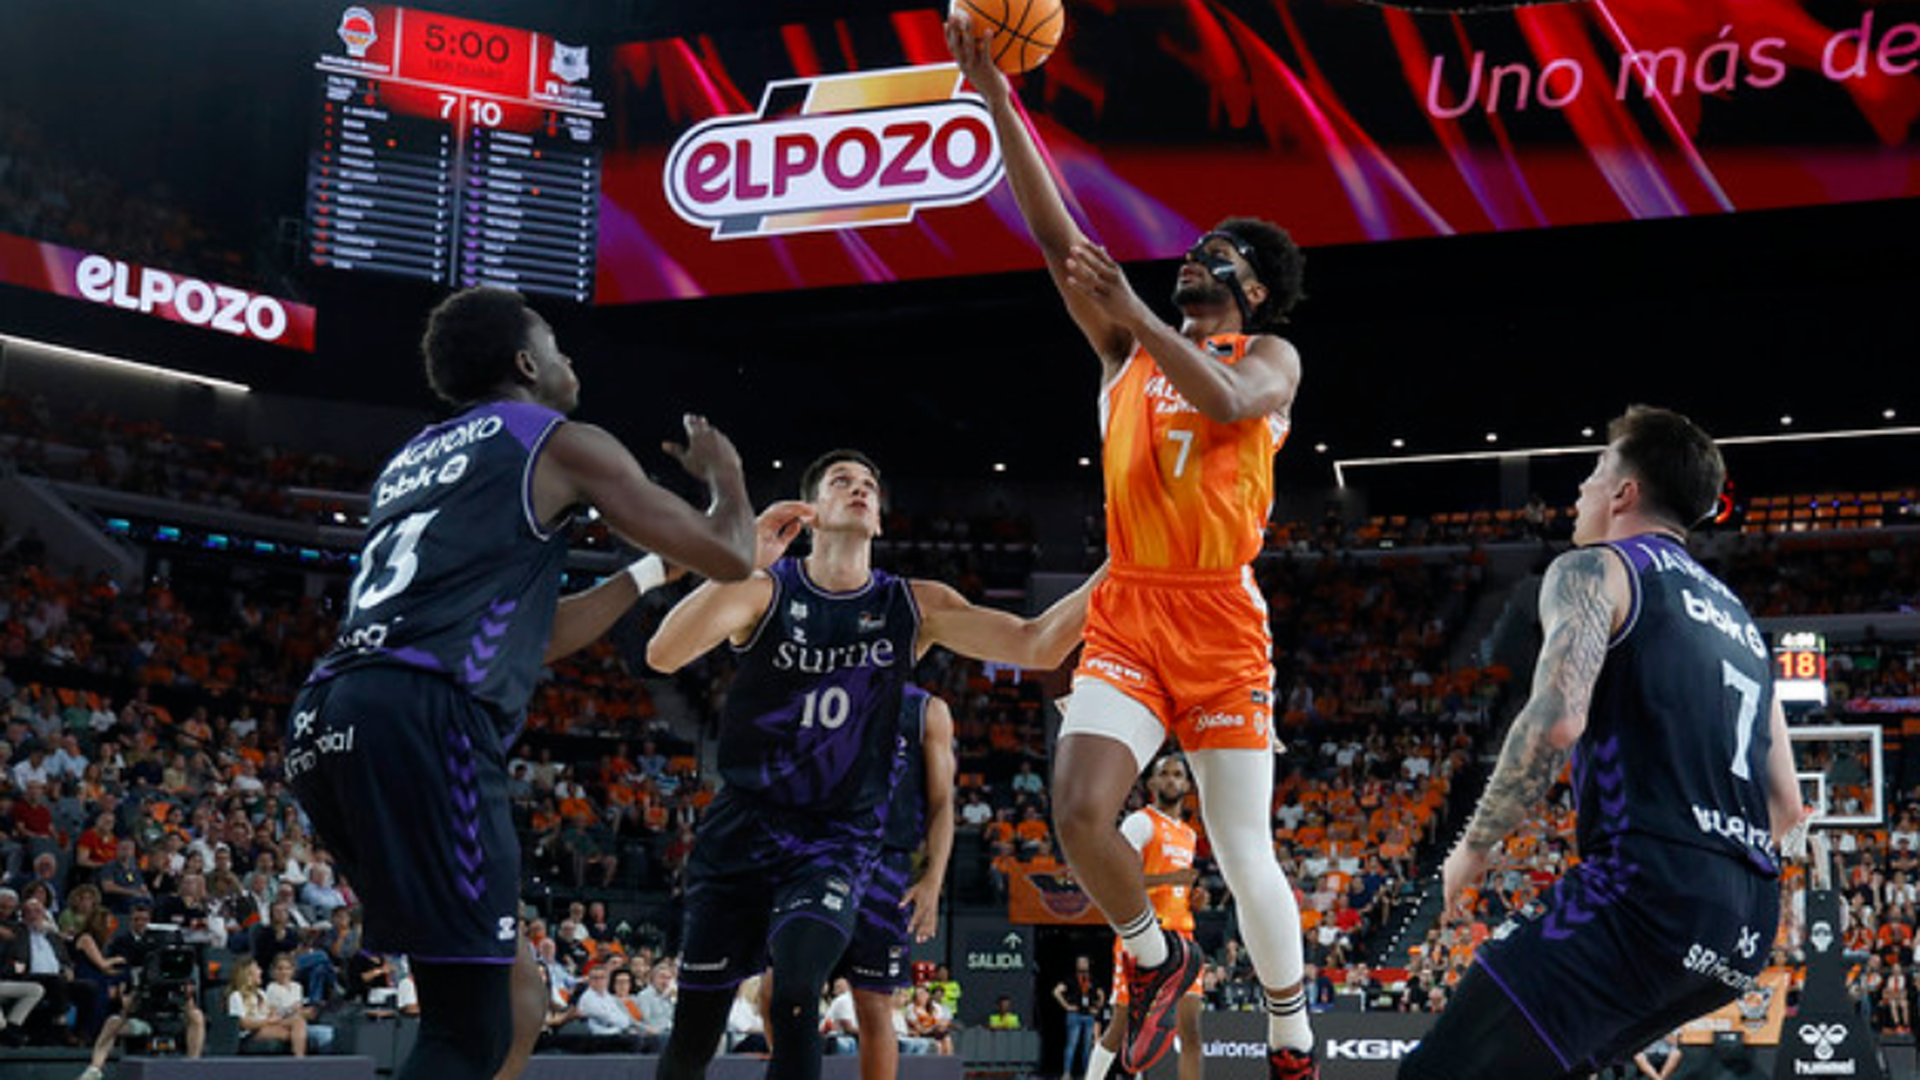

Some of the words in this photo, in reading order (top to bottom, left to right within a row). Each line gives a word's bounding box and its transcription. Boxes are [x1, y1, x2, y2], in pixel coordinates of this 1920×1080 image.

[425, 24, 510, 63] 5:00
[1427, 51, 1583, 119] Uno
[1615, 24, 1786, 100] más
[1820, 9, 1920, 82] de
[439, 94, 457, 119] 7
[469, 100, 502, 126] 10
[1167, 430, 1193, 478] 7
[376, 465, 436, 508] bbk
[347, 509, 440, 624] 13
[1778, 651, 1816, 678] 18
[800, 686, 850, 729] 10
[1722, 659, 1761, 780] 7
[967, 952, 1024, 969] SALIDA
[1326, 1040, 1422, 1059] KGM
[1794, 1058, 1856, 1075] hummel
